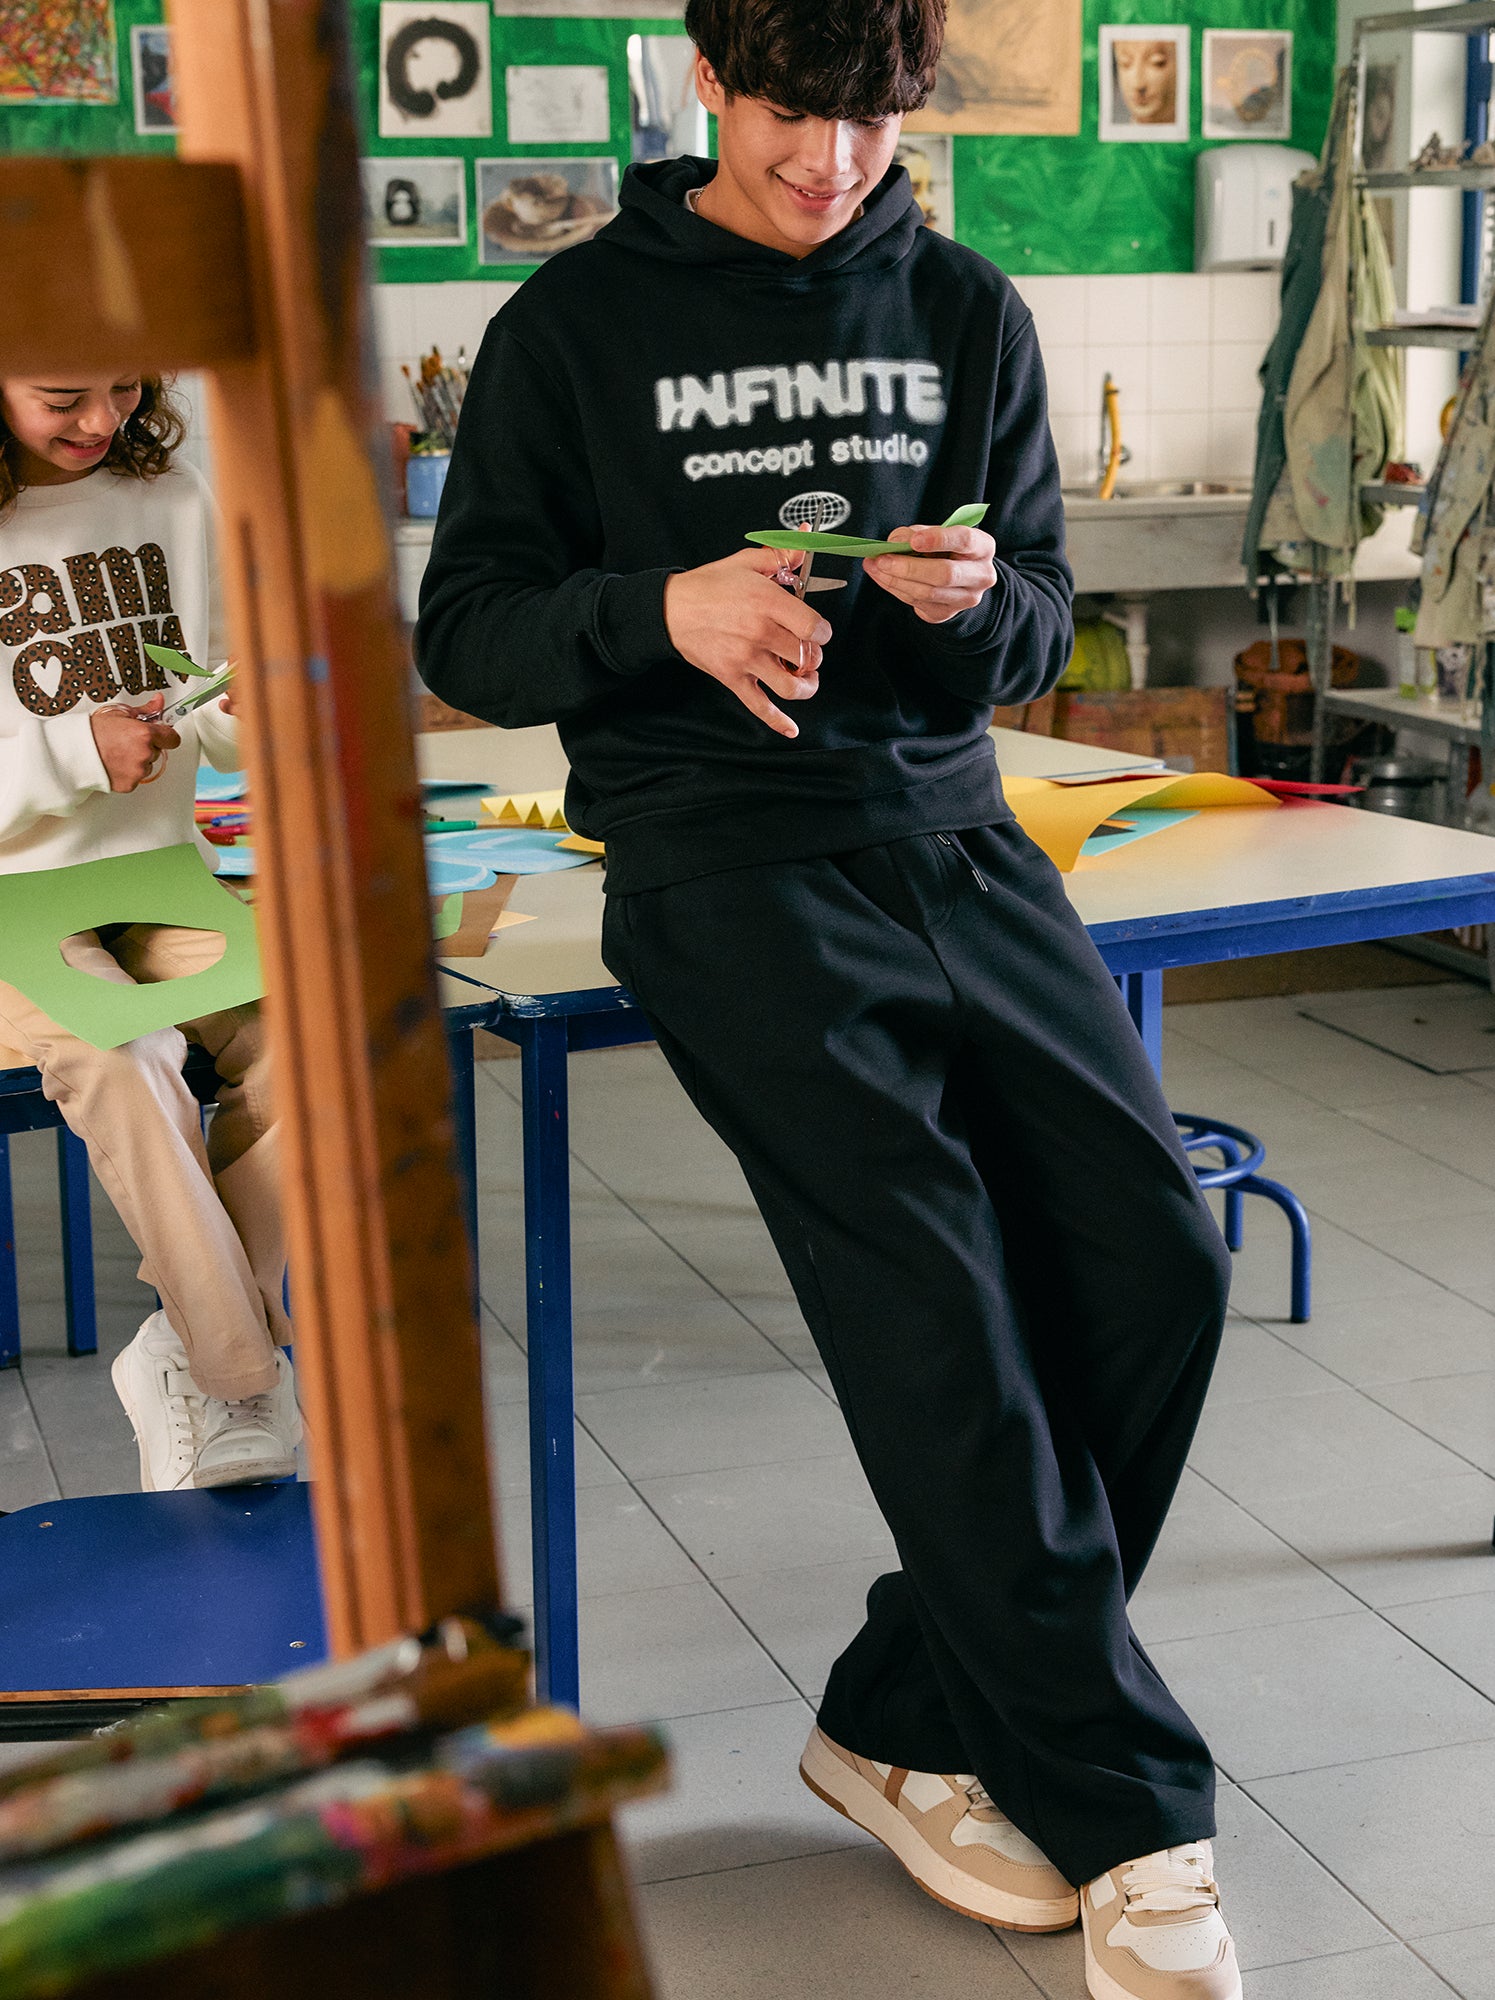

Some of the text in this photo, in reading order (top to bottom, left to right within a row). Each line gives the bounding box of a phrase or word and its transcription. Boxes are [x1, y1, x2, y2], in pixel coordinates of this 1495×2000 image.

[656, 360, 946, 431] INFINITE
[684, 434, 929, 481] concept studio
